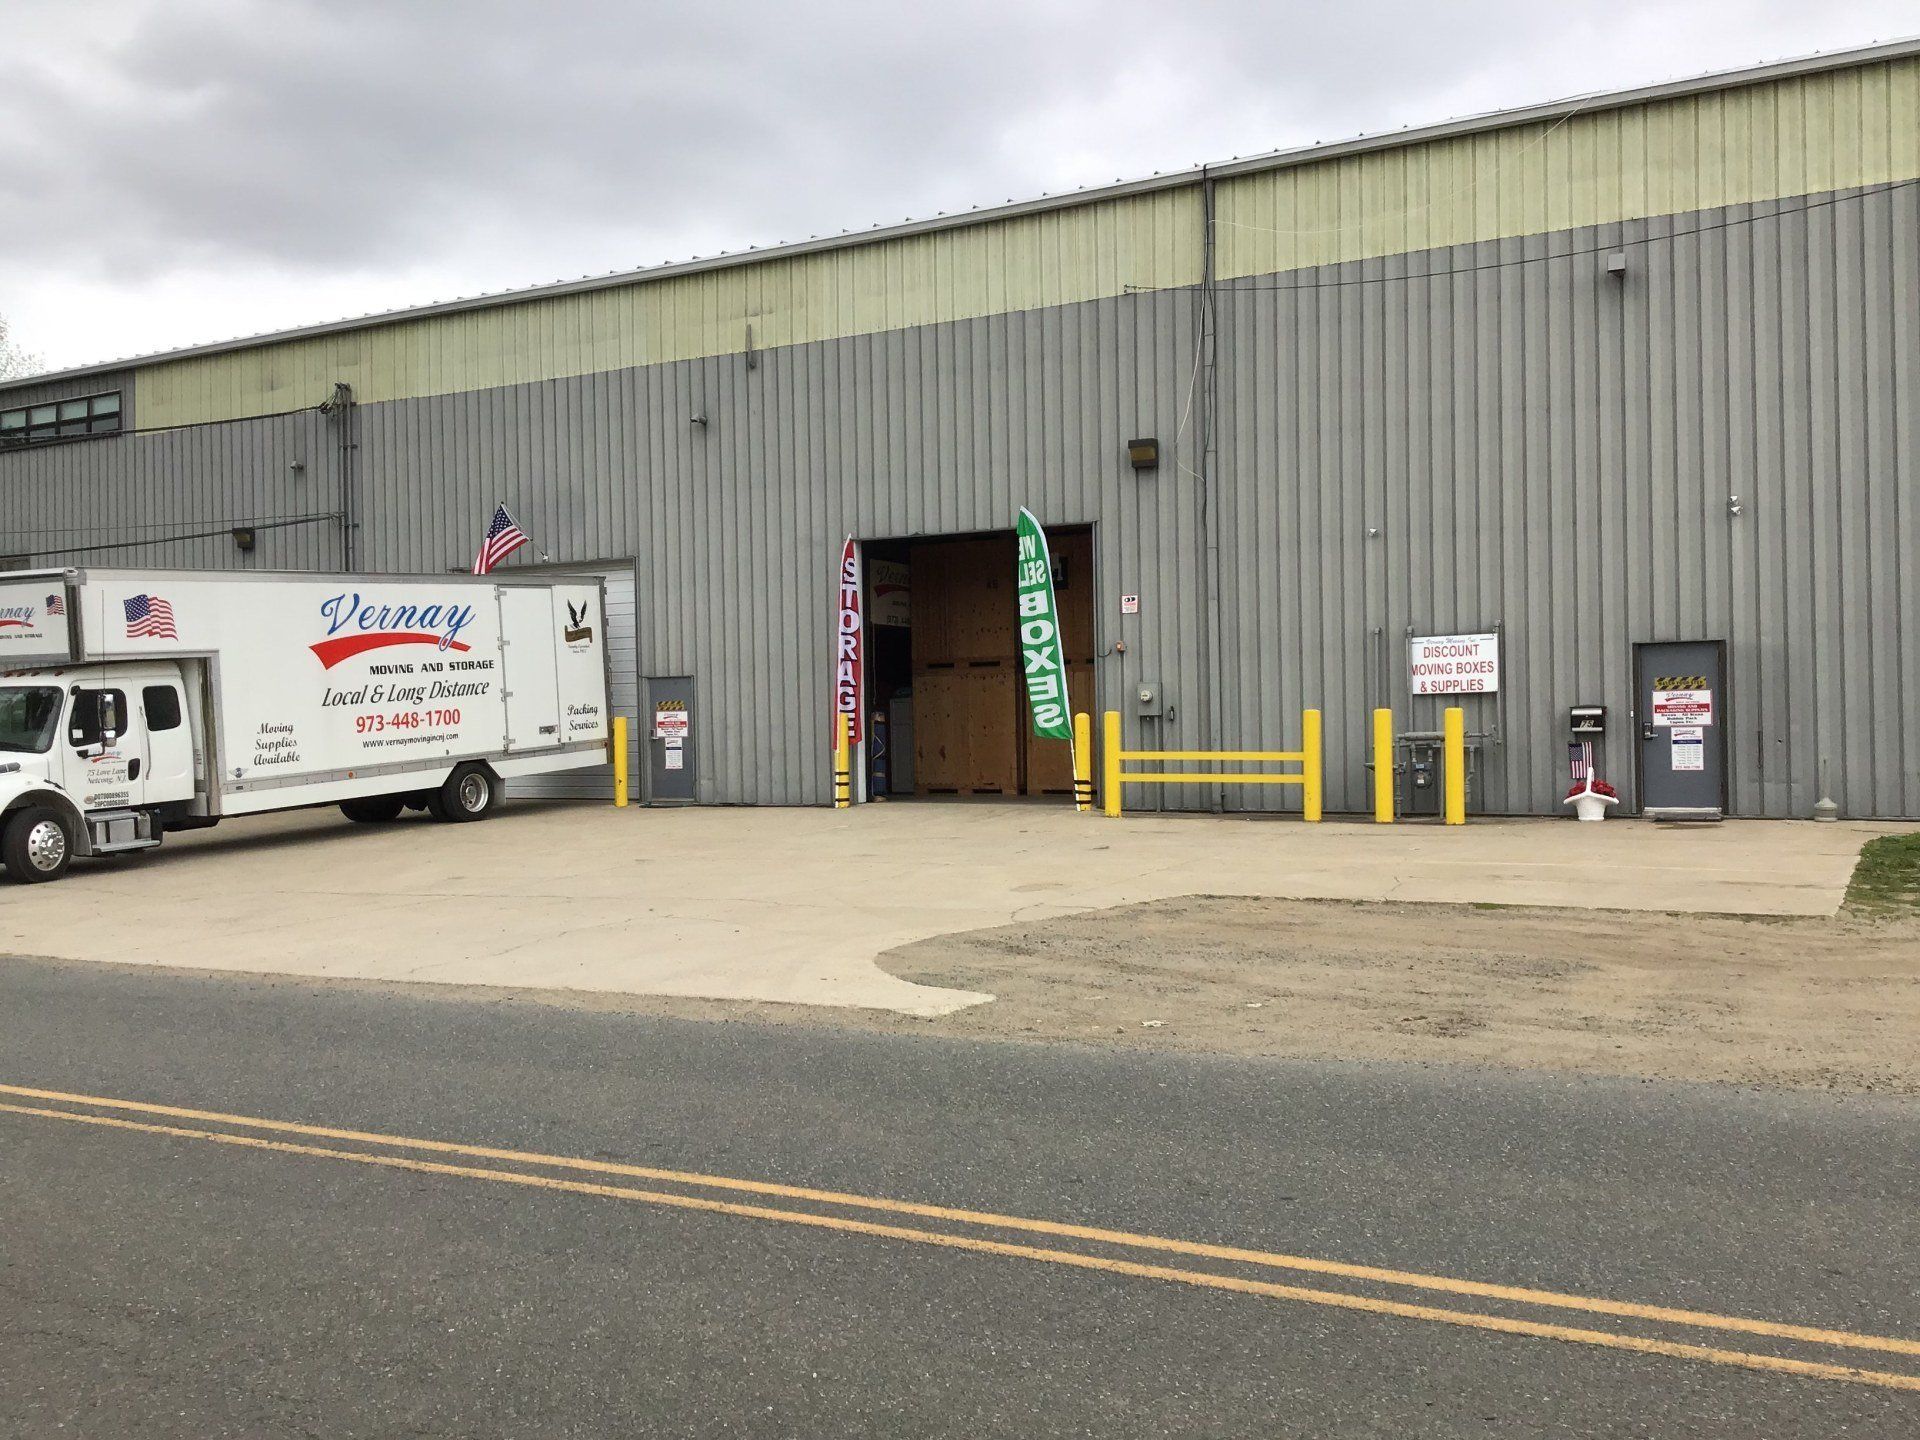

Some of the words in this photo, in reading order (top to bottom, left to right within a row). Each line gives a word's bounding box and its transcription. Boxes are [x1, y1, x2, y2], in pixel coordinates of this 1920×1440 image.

[320, 593, 476, 652] Vernay
[840, 558, 860, 736] STORAGE
[1423, 644, 1479, 658] DISCOUNT
[369, 663, 414, 675] MOVING
[420, 662, 444, 673] AND
[449, 659, 495, 671] STORAGE
[1411, 662, 1452, 676] MOVING
[1456, 661, 1494, 674] BOXES
[1420, 681, 1427, 692] &
[1431, 679, 1484, 692] SUPPLIES
[322, 684, 369, 707] Local
[370, 684, 385, 703] &
[387, 684, 427, 705] Long
[429, 680, 490, 699] Distance
[567, 703, 599, 717] Packing
[257, 722, 294, 735] Moving
[356, 709, 461, 733] 973-448-1700
[568, 718, 599, 732] Services
[254, 737, 298, 752] Supplies
[253, 751, 301, 766] Available
